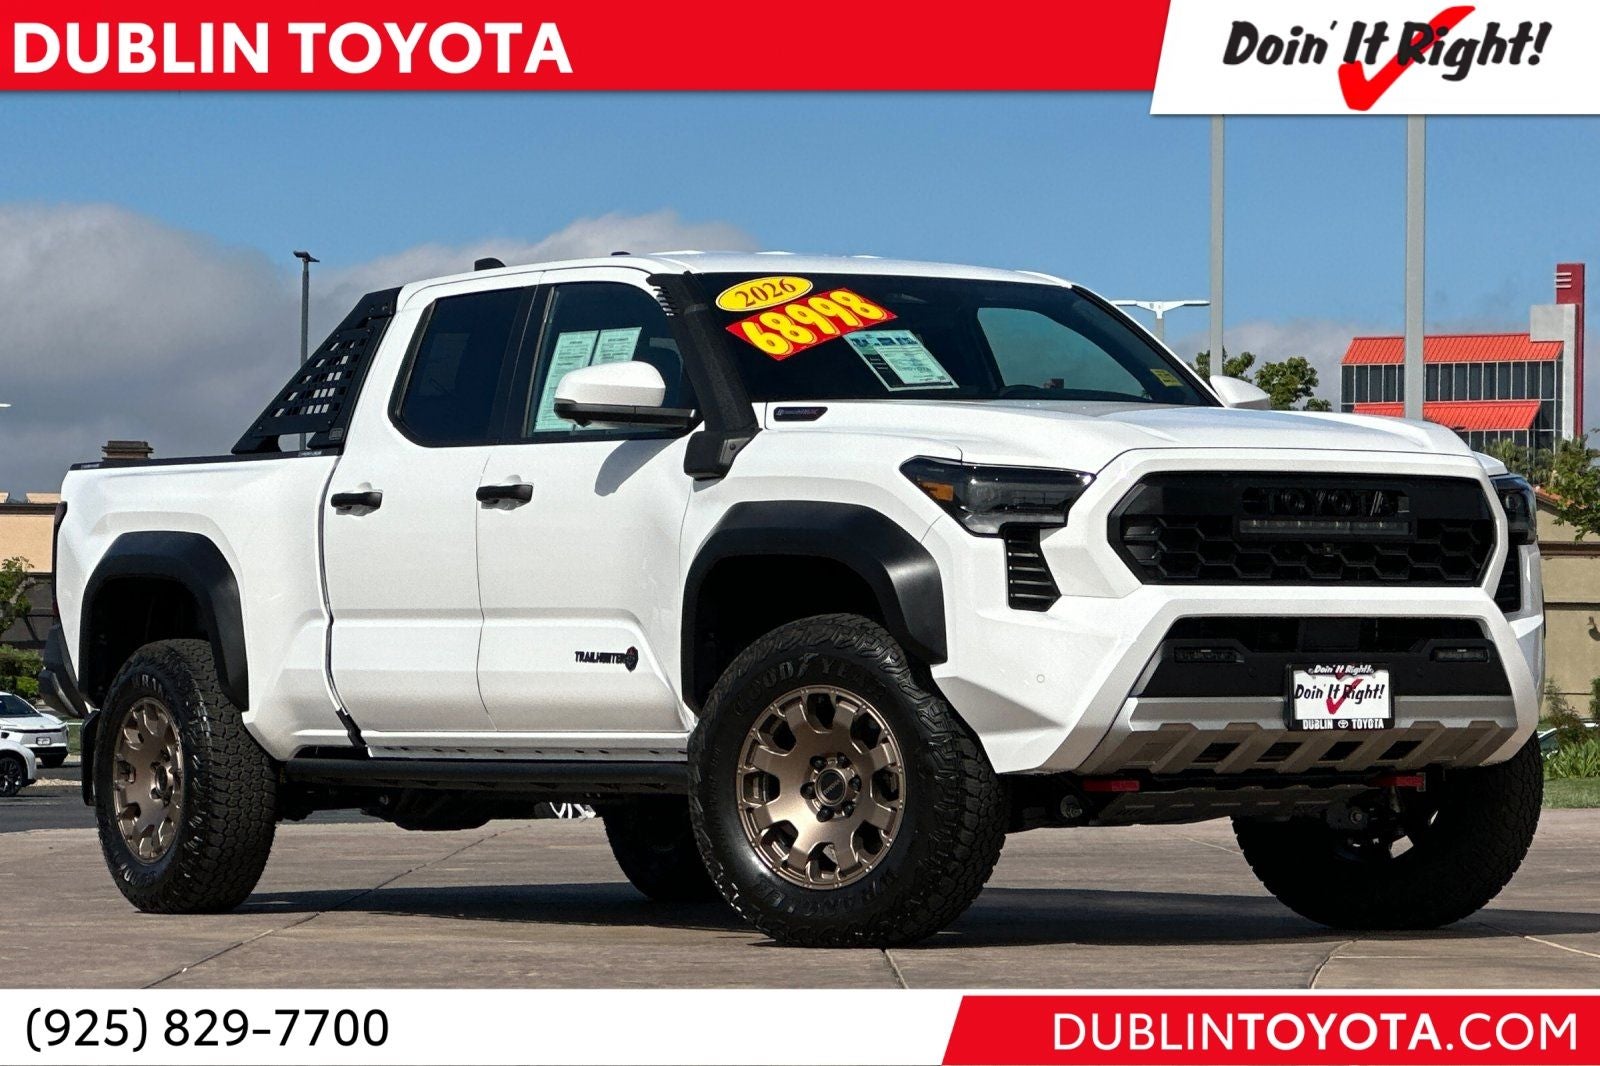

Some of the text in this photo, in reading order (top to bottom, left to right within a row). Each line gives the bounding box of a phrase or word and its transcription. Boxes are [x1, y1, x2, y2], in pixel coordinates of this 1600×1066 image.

[735, 278, 797, 307] 2026
[741, 290, 888, 356] 68998
[1335, 664, 1345, 674] It
[1295, 683, 1386, 705] Doin' It Right!
[1303, 718, 1385, 730] DUBLIN TOYOTA
